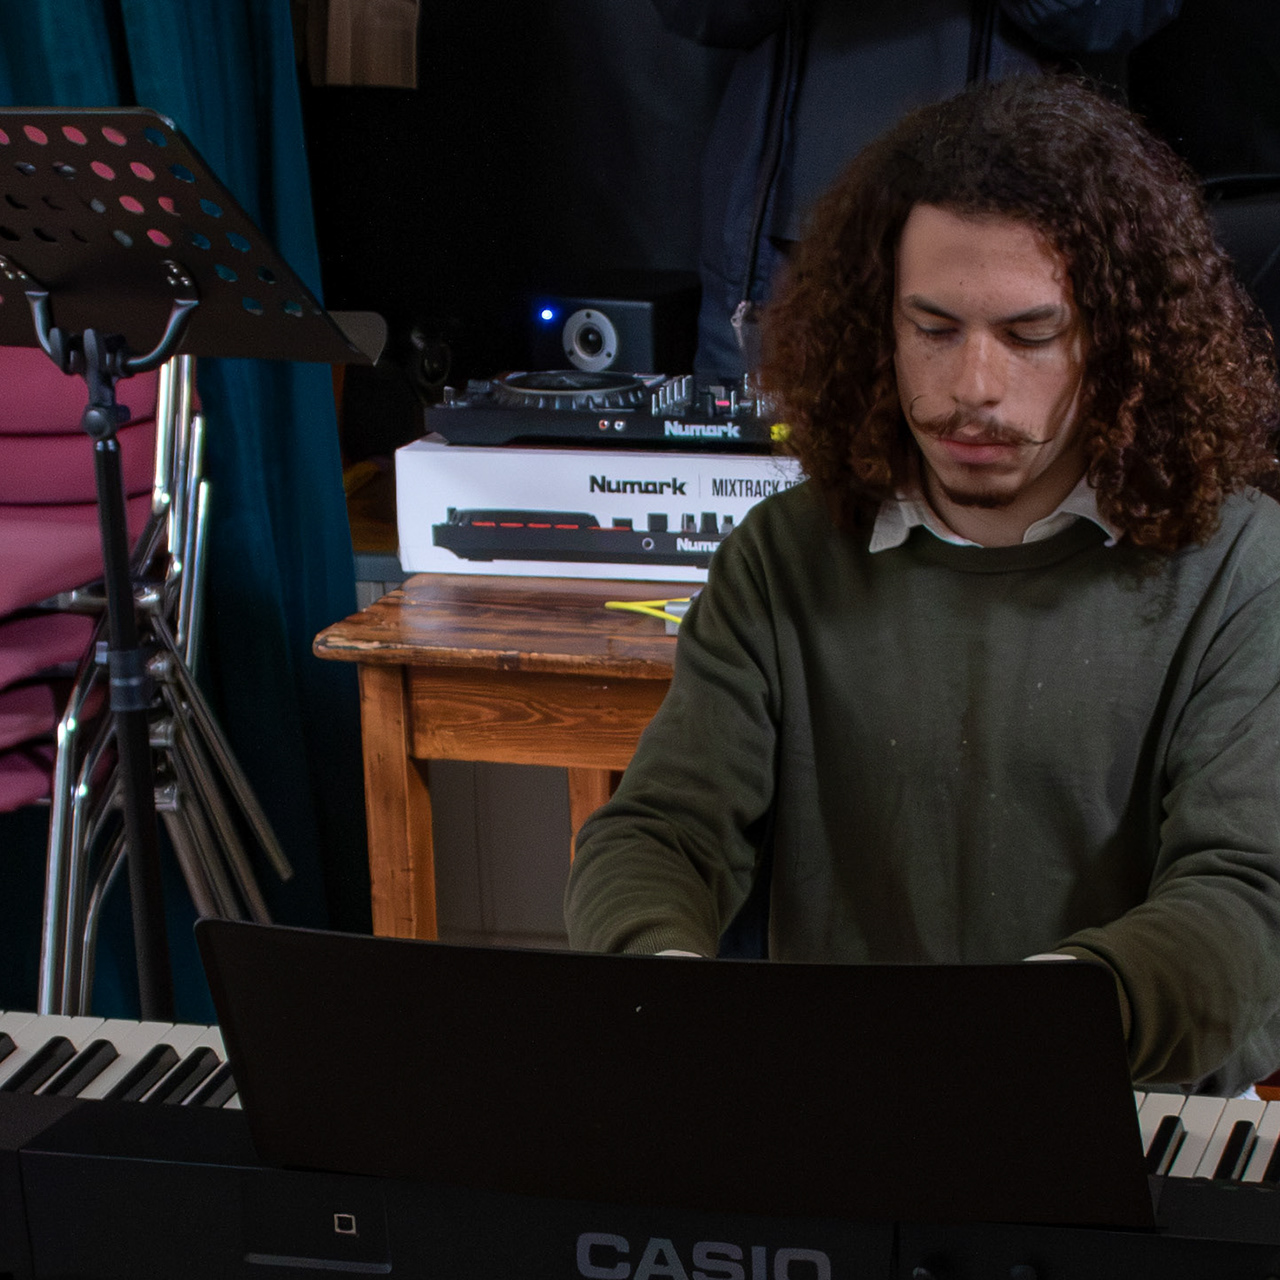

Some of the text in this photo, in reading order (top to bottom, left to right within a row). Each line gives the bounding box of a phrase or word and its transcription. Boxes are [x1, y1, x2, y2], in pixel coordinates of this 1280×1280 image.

[664, 420, 741, 438] Numark
[589, 475, 686, 495] Numark
[712, 477, 780, 498] MIXTRACK
[677, 537, 720, 552] Num
